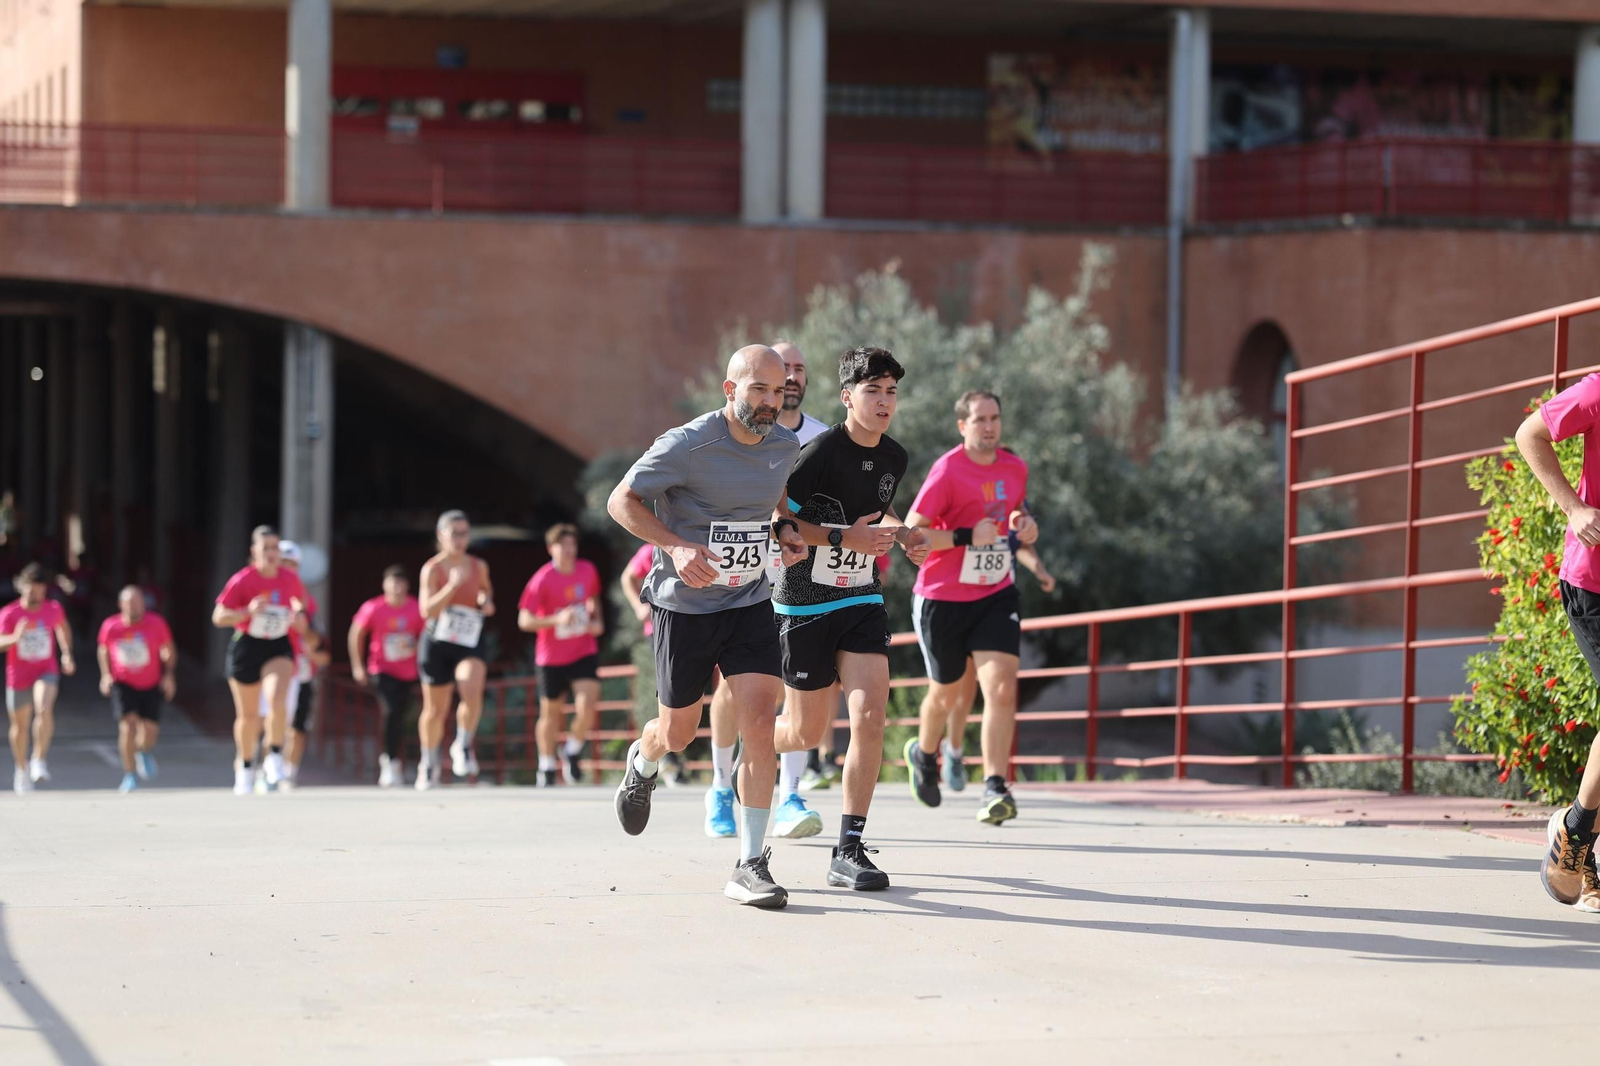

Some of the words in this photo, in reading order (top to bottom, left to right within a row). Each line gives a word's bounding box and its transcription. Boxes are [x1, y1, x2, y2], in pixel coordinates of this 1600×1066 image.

[981, 480, 1007, 501] WE
[714, 533, 744, 542] UMA
[719, 544, 761, 569] 343
[827, 547, 867, 569] 341
[973, 553, 1004, 571] 188
